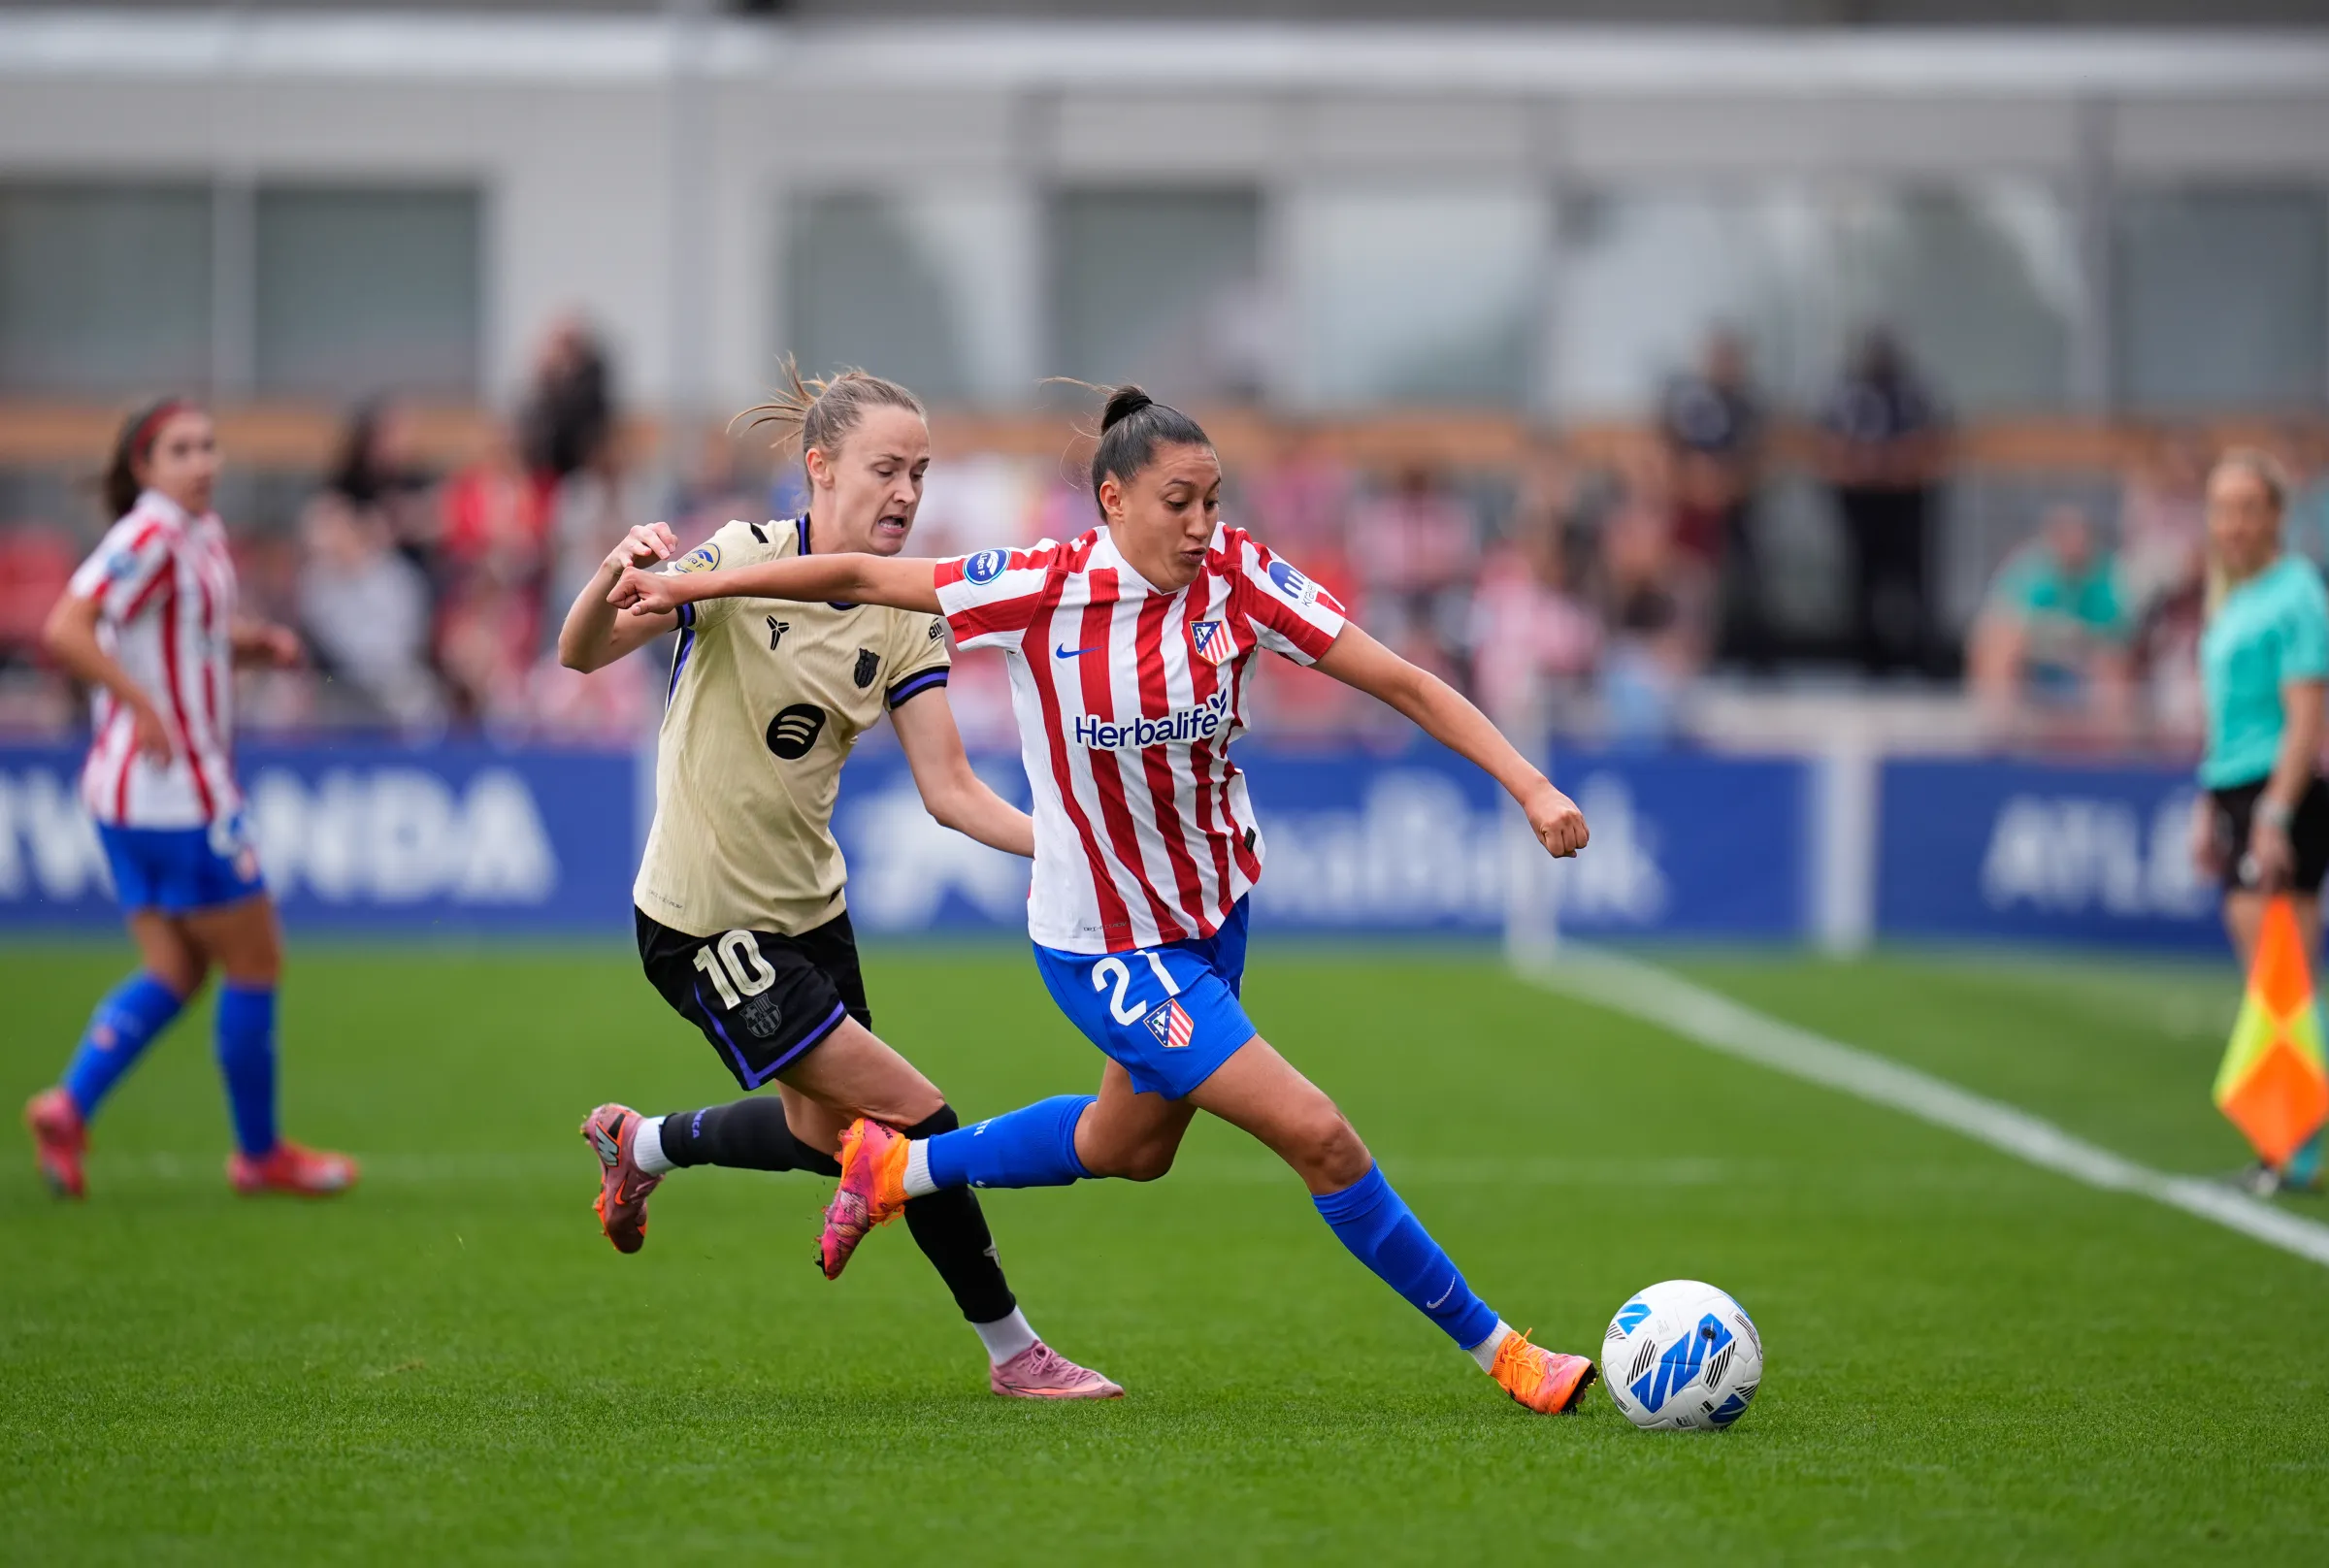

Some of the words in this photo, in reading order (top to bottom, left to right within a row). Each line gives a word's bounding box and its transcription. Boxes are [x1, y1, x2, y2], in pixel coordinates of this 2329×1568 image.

[1075, 707, 1219, 748] Herbalife
[692, 929, 776, 1010] 10
[1091, 949, 1181, 1027] 21
